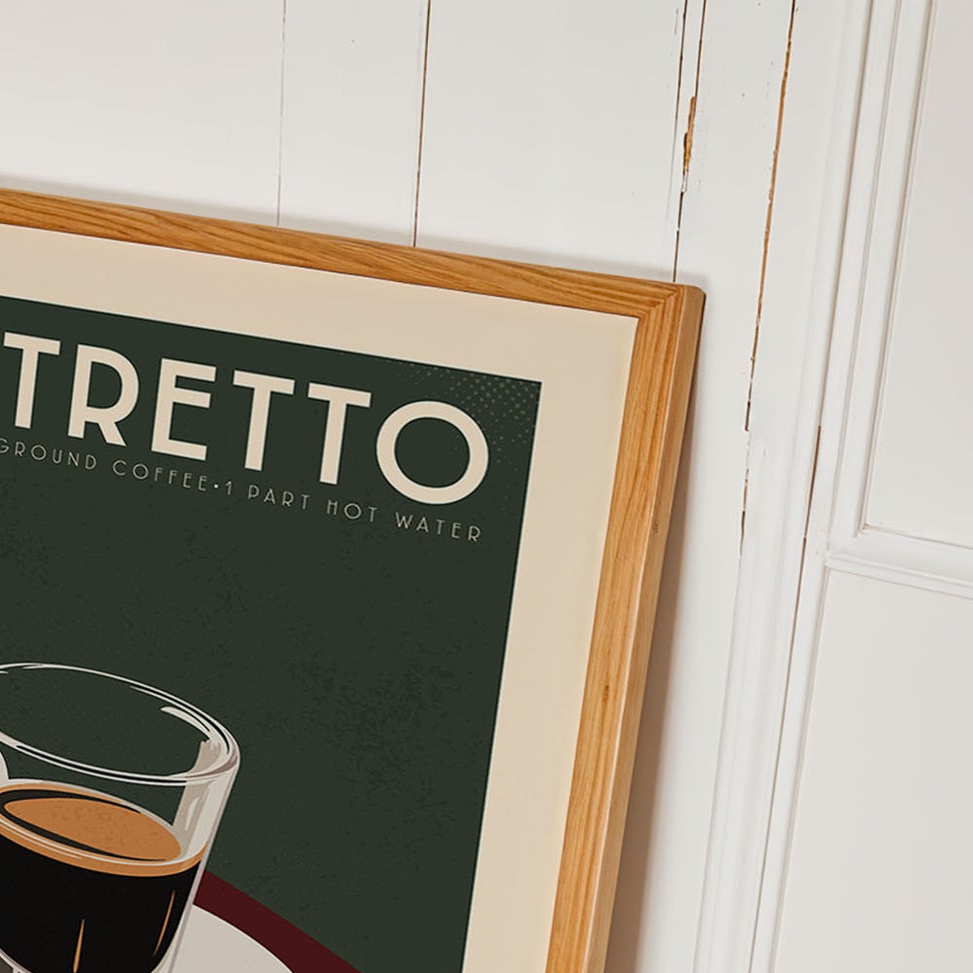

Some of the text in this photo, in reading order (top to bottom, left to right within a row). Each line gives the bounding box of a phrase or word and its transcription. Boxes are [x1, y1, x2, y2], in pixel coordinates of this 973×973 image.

[247, 483, 311, 510] PART
[326, 498, 378, 523] HOT
[395, 511, 482, 542] WATER
